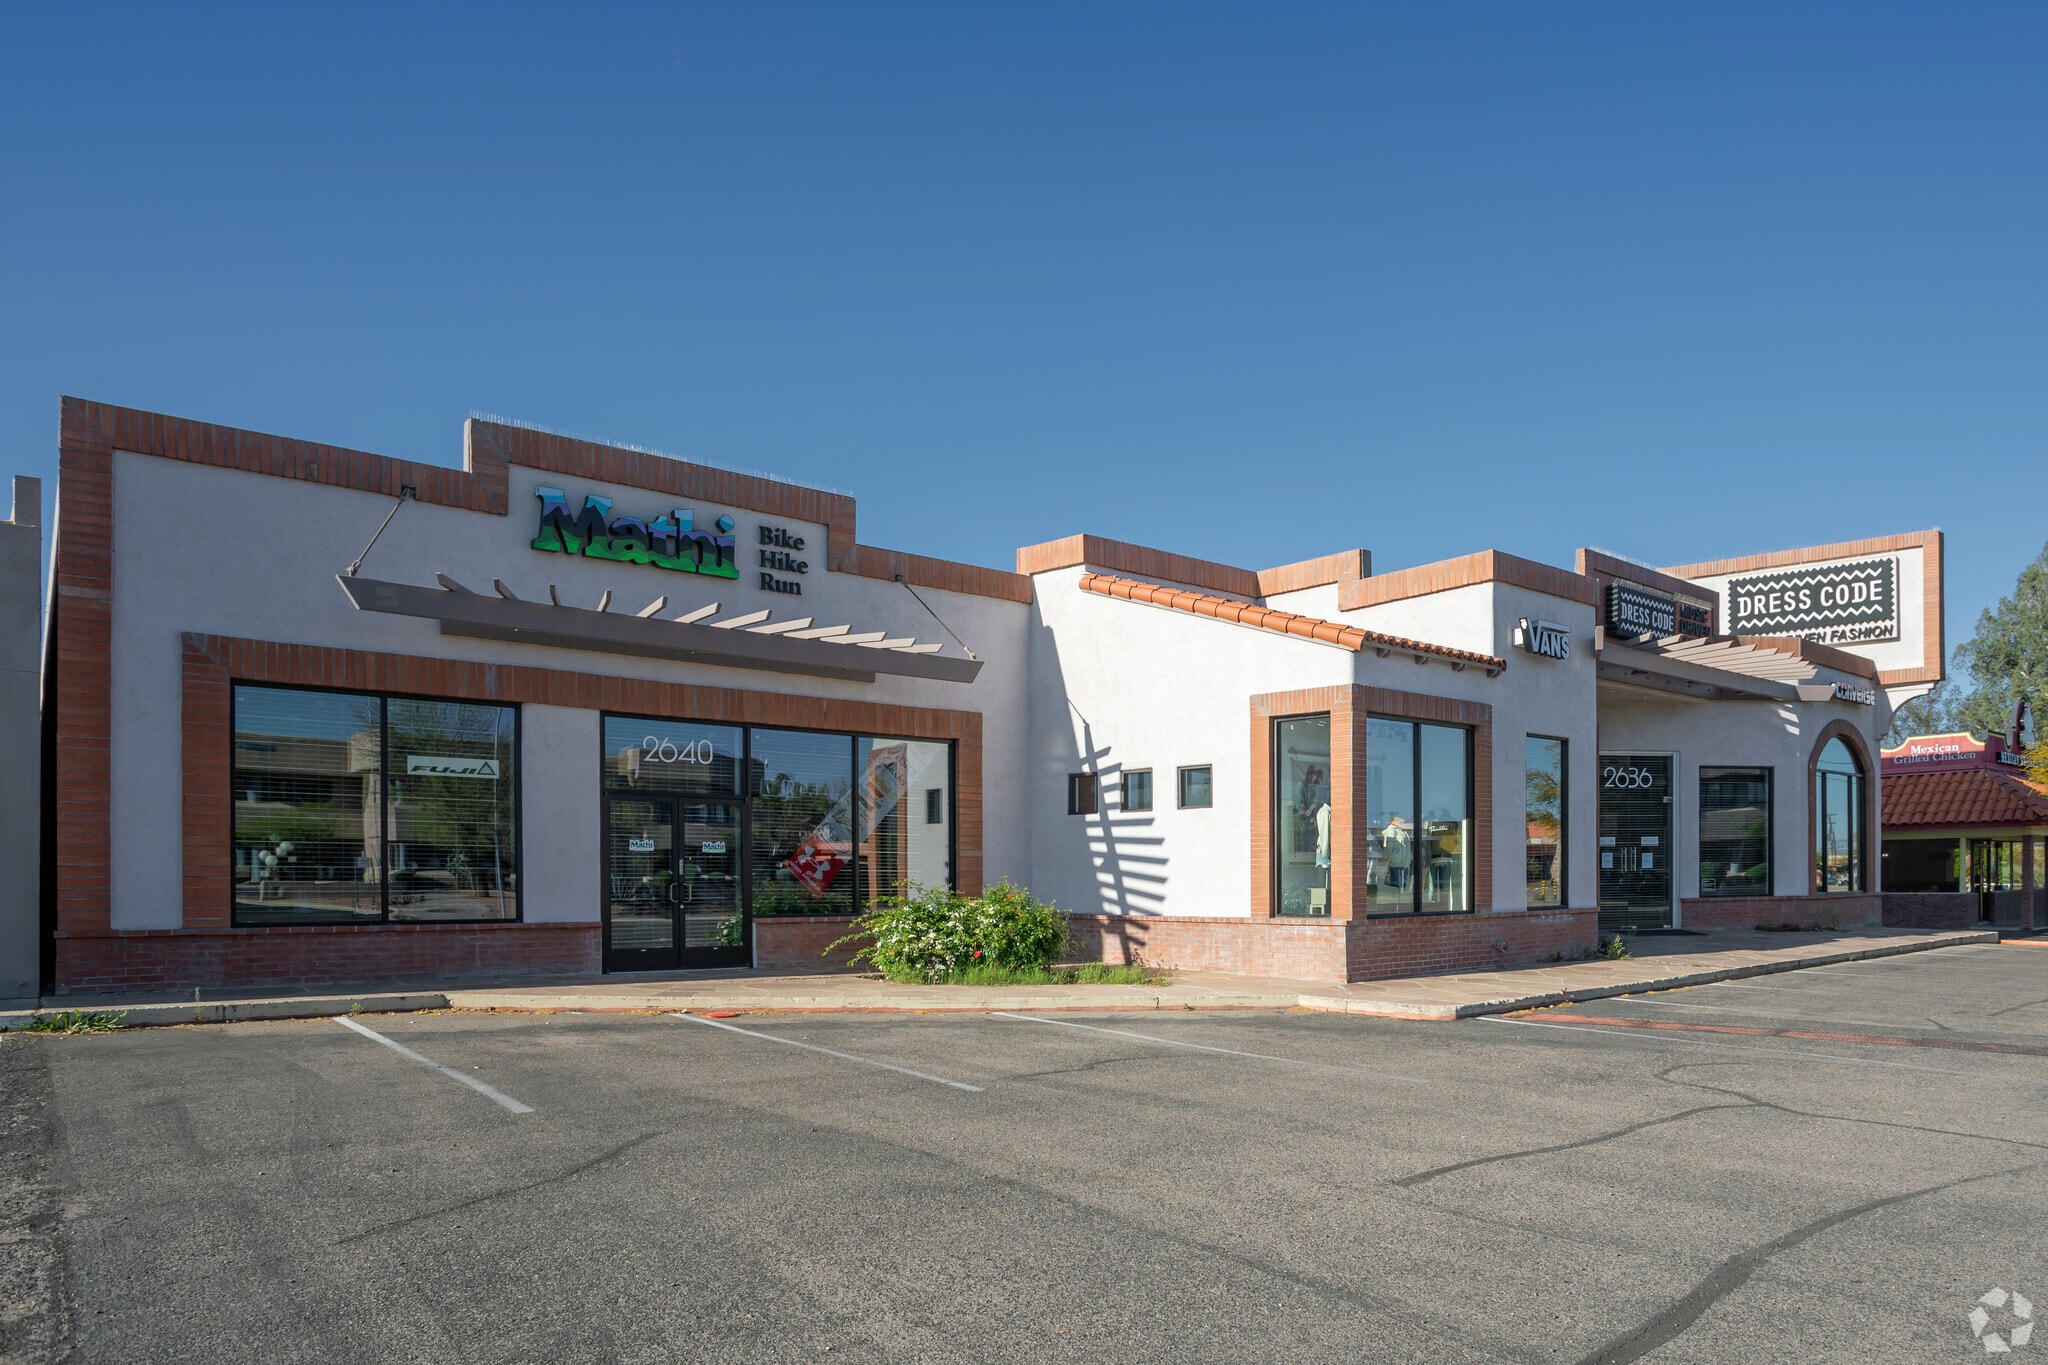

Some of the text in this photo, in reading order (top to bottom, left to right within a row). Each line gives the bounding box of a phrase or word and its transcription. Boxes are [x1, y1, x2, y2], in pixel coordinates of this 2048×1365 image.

[531, 486, 740, 580] Mathi
[758, 526, 806, 551] Bike
[759, 550, 809, 575] Hike
[759, 572, 802, 596] Run
[1737, 579, 1883, 617] DRESS CODE
[1620, 602, 1674, 632] DRESS CODE
[1681, 604, 1708, 622] MUSIC
[1525, 617, 1571, 660] VANS
[1680, 620, 1713, 637] DRIVEN
[1830, 624, 1894, 642] FASHION
[1836, 681, 1876, 706] CONVERSE
[642, 735, 714, 765] 2640
[1893, 751, 1977, 765] Grilled Chicken
[1910, 743, 1960, 755] Mexican
[411, 765, 477, 775] FUJI
[1603, 766, 1653, 789] 2636
[630, 840, 653, 849] Mathi
[703, 842, 725, 850] Mathi
